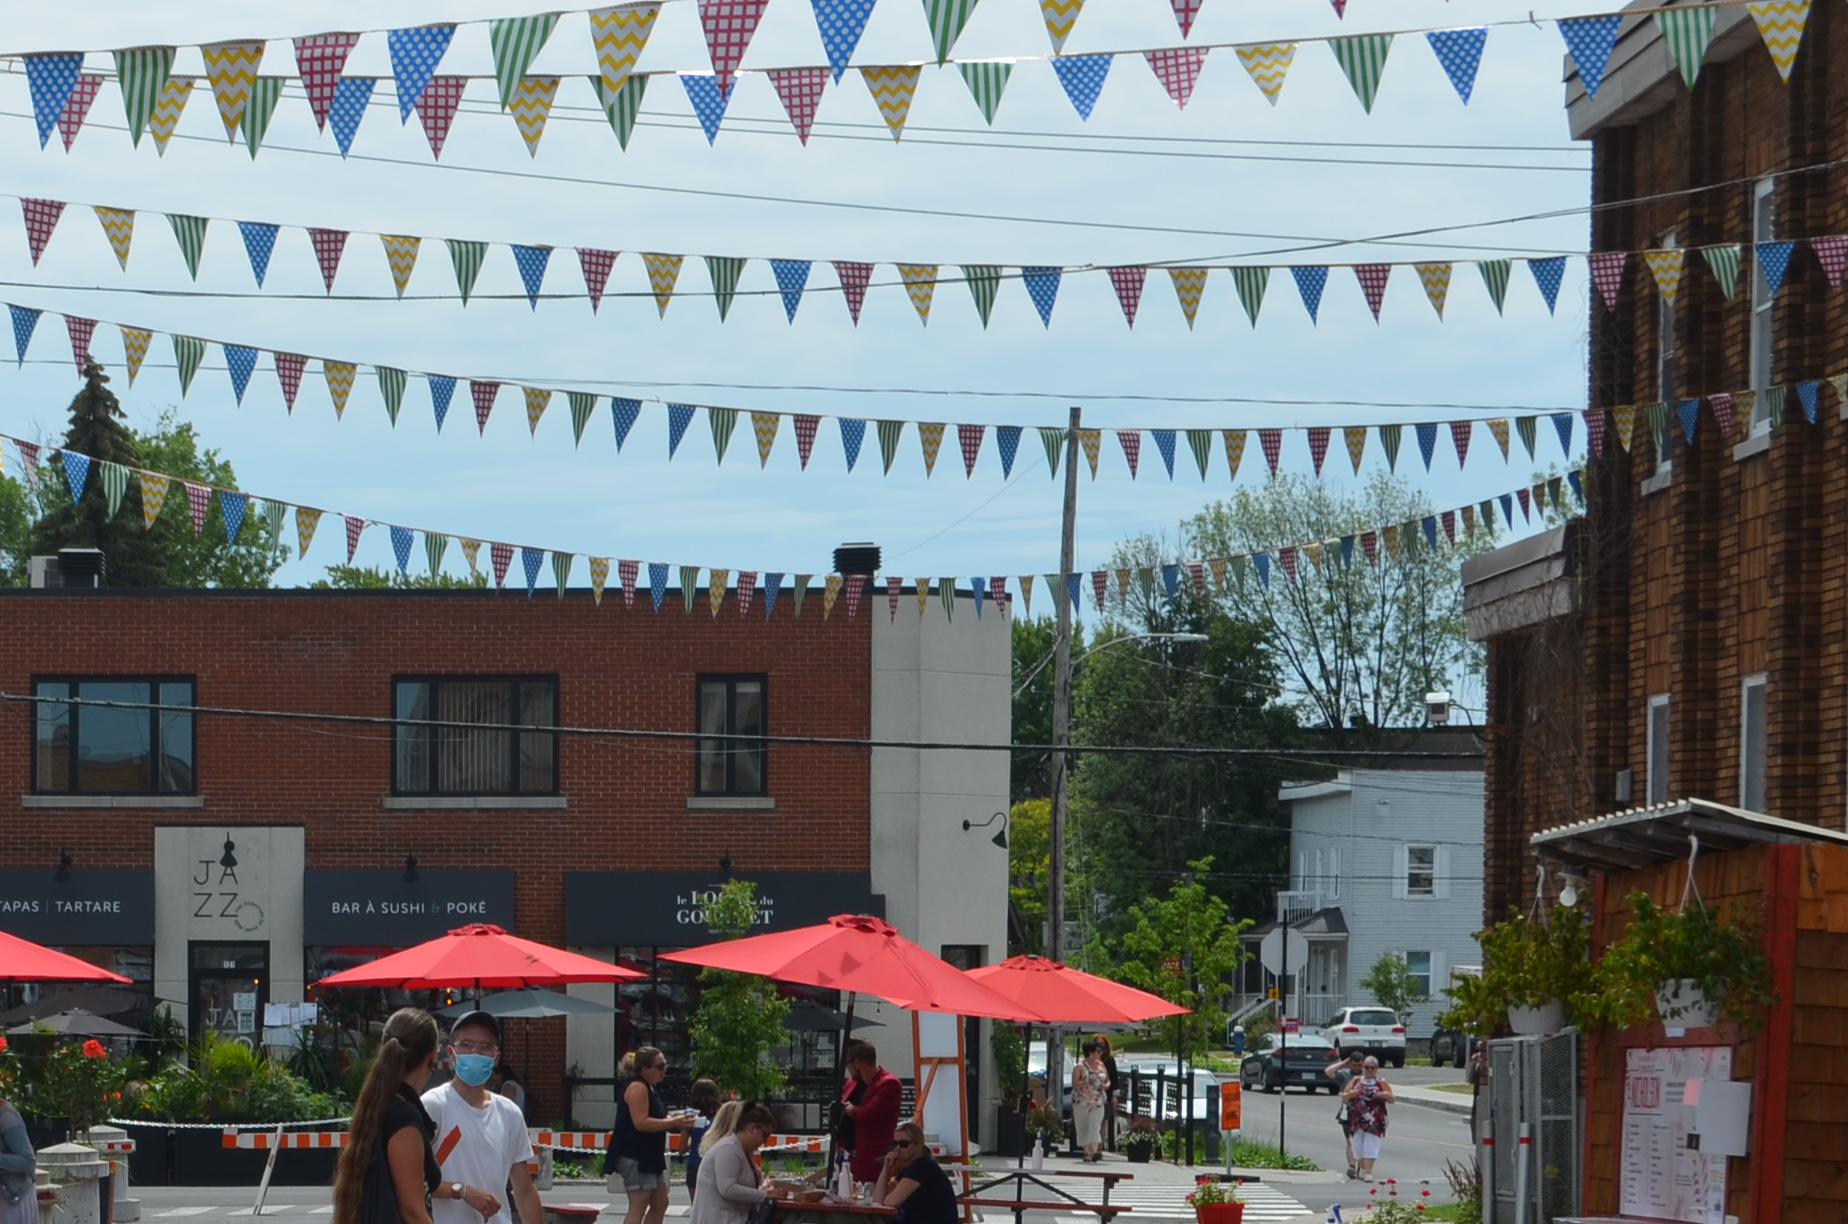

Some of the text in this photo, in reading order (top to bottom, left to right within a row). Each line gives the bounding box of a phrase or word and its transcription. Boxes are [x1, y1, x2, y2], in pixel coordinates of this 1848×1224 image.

[676, 895, 687, 905] le
[759, 896, 774, 905] du
[55, 901, 121, 913] TARTARE
[332, 900, 486, 914] BAR À SUSHI & POKÉ
[676, 909, 774, 924] GOET
